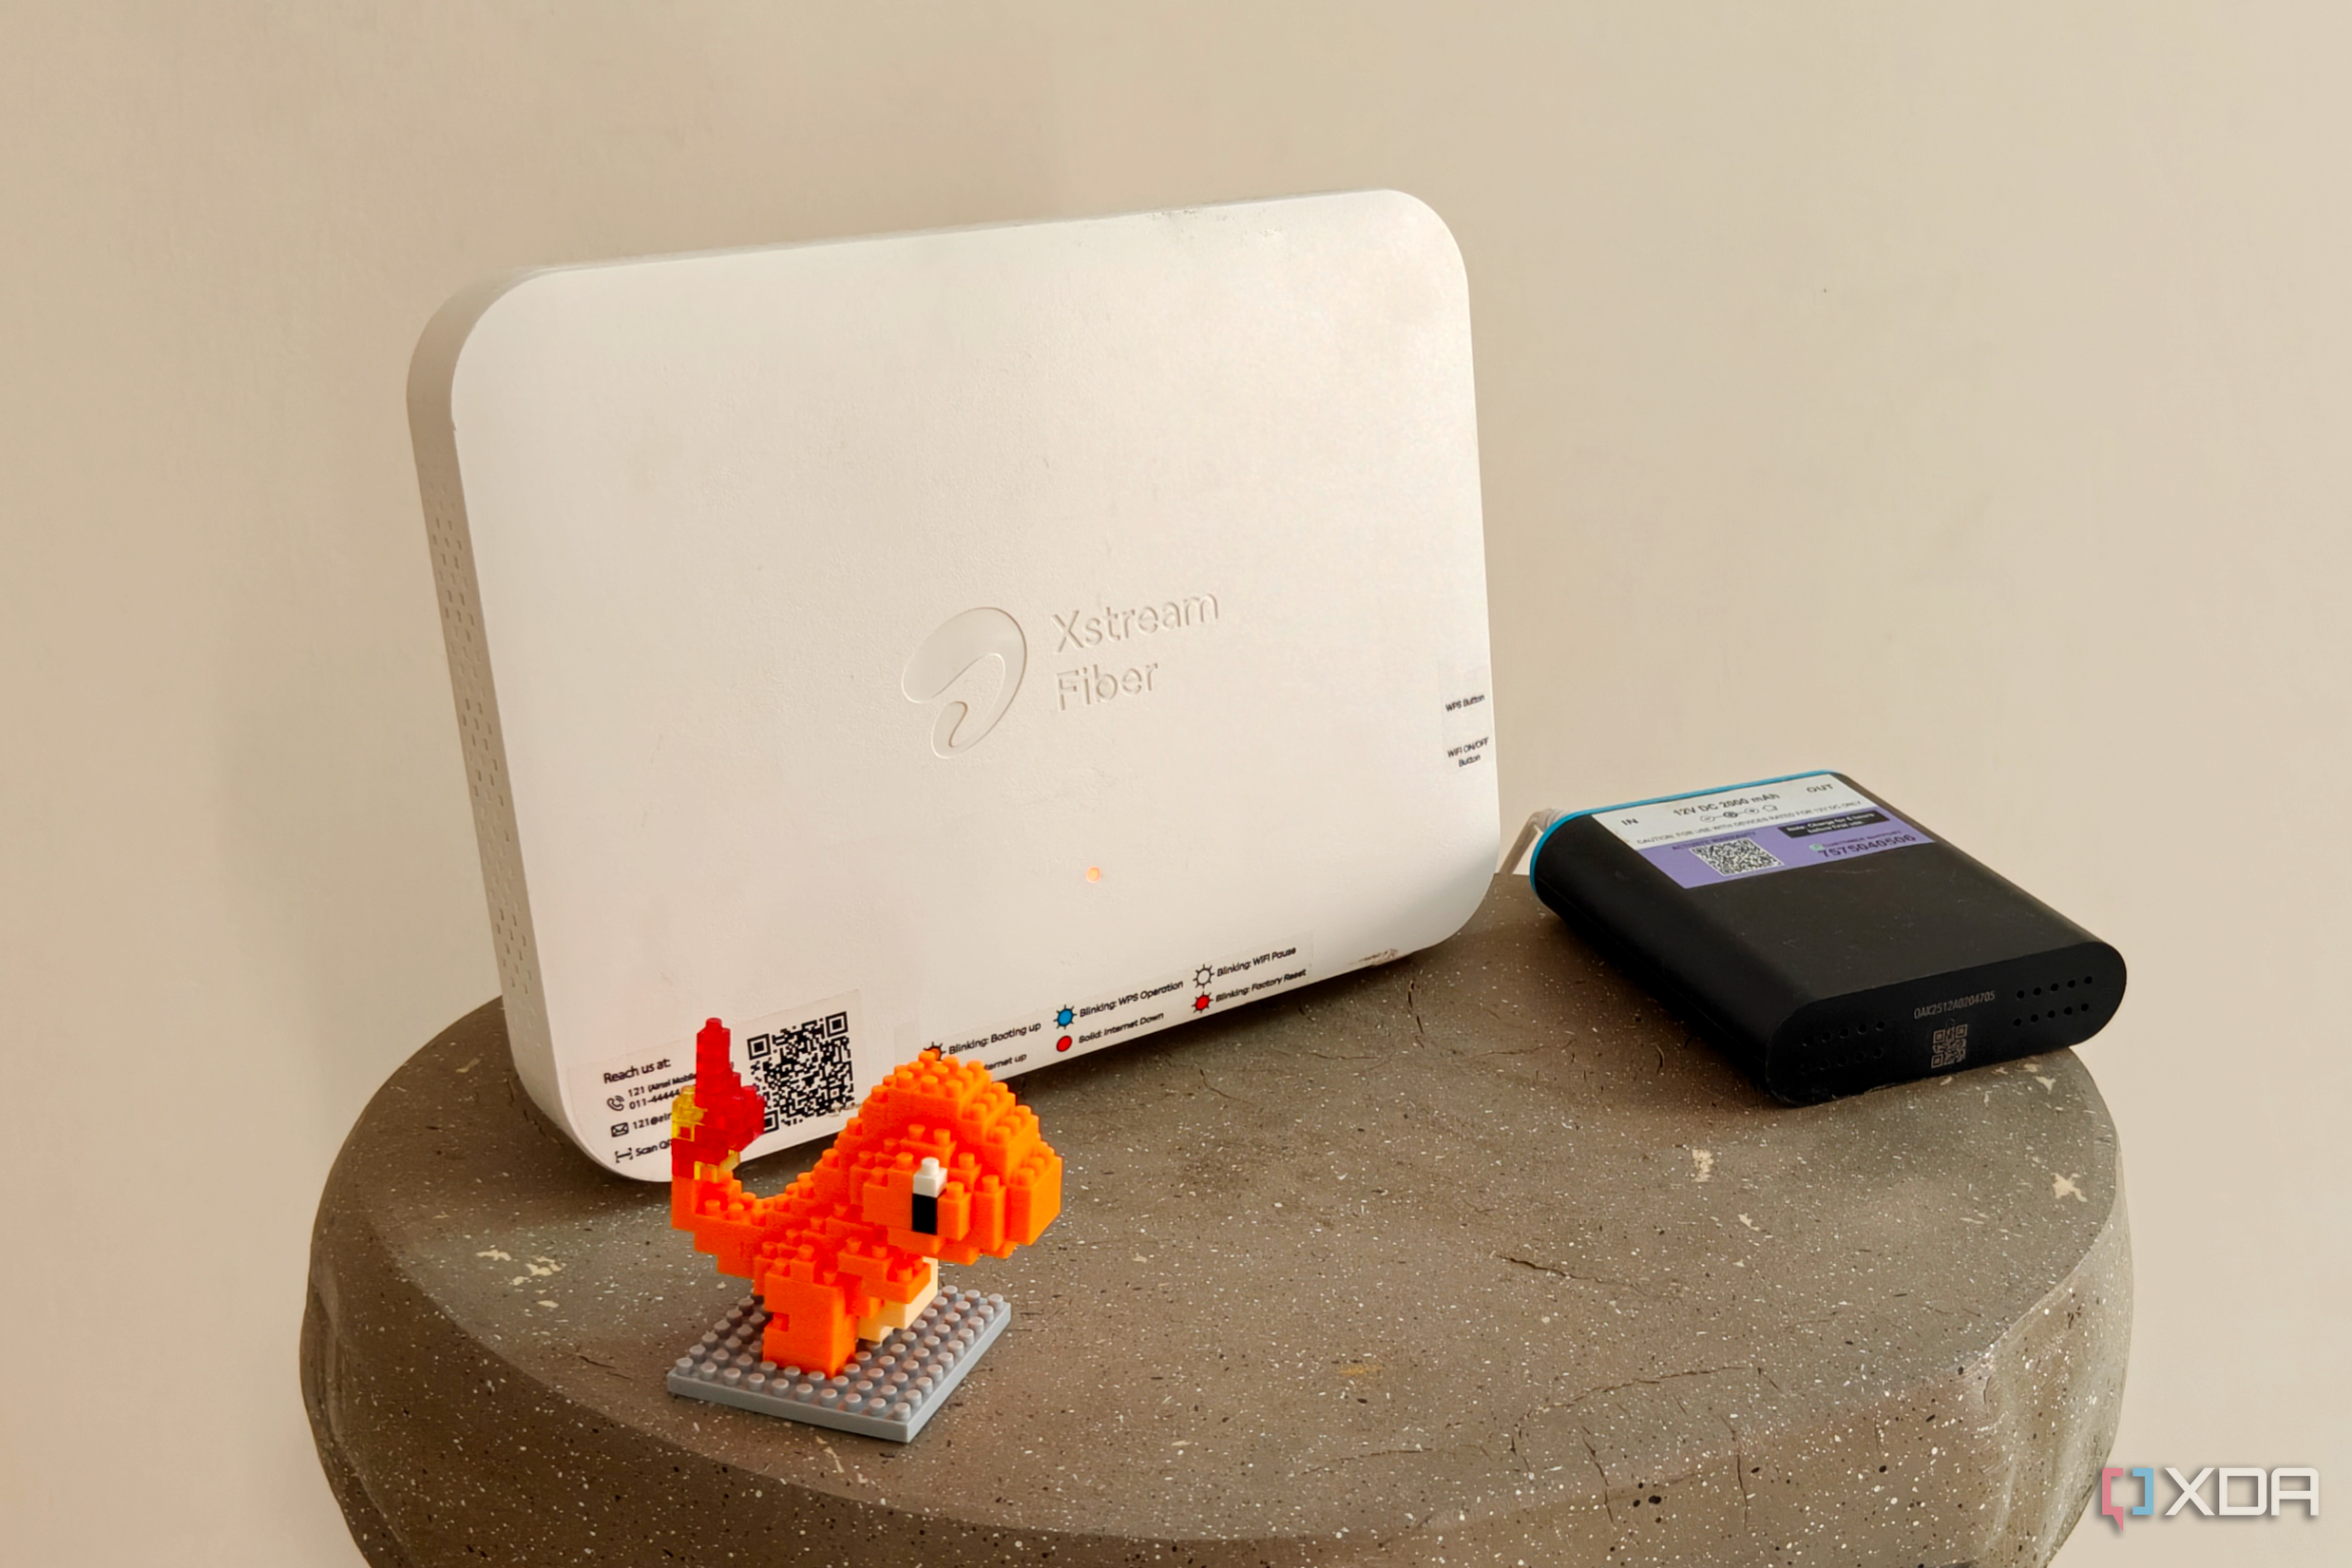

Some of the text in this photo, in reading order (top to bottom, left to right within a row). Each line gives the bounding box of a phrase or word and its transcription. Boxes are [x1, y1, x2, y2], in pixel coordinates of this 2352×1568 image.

[1050, 593, 1219, 654] Xstream
[1055, 662, 1158, 713] Fiber
[1445, 695, 1484, 712] WPS Button
[1463, 736, 1489, 754] ON/OFF
[1459, 755, 1481, 768] Button
[1807, 784, 1833, 794] OUT
[1673, 807, 1696, 816] 12V
[1698, 803, 1719, 813] DC
[1750, 793, 1780, 803] mAh
[1621, 818, 1639, 827] IN
[1818, 833, 1917, 858] 7575040506
[1217, 961, 1252, 977] Blinking:
[1272, 947, 1296, 962] Pause
[1215, 968, 1307, 1003] Blinking: Factory Reset
[1080, 981, 1184, 1018] Blinking: WPS Operation
[1079, 1012, 1164, 1043] Solid: Internet Down
[948, 1023, 1042, 1056] Blinking: Booting up
[984, 1053, 1027, 1070] ternet up
[603, 1065, 640, 1084] Reach
[641, 1063, 655, 1075] us
[628, 1086, 645, 1097] 121
[628, 1088, 680, 1110] 011-44444
[633, 1112, 672, 1130] 121@air
[635, 1144, 658, 1157] Scan
